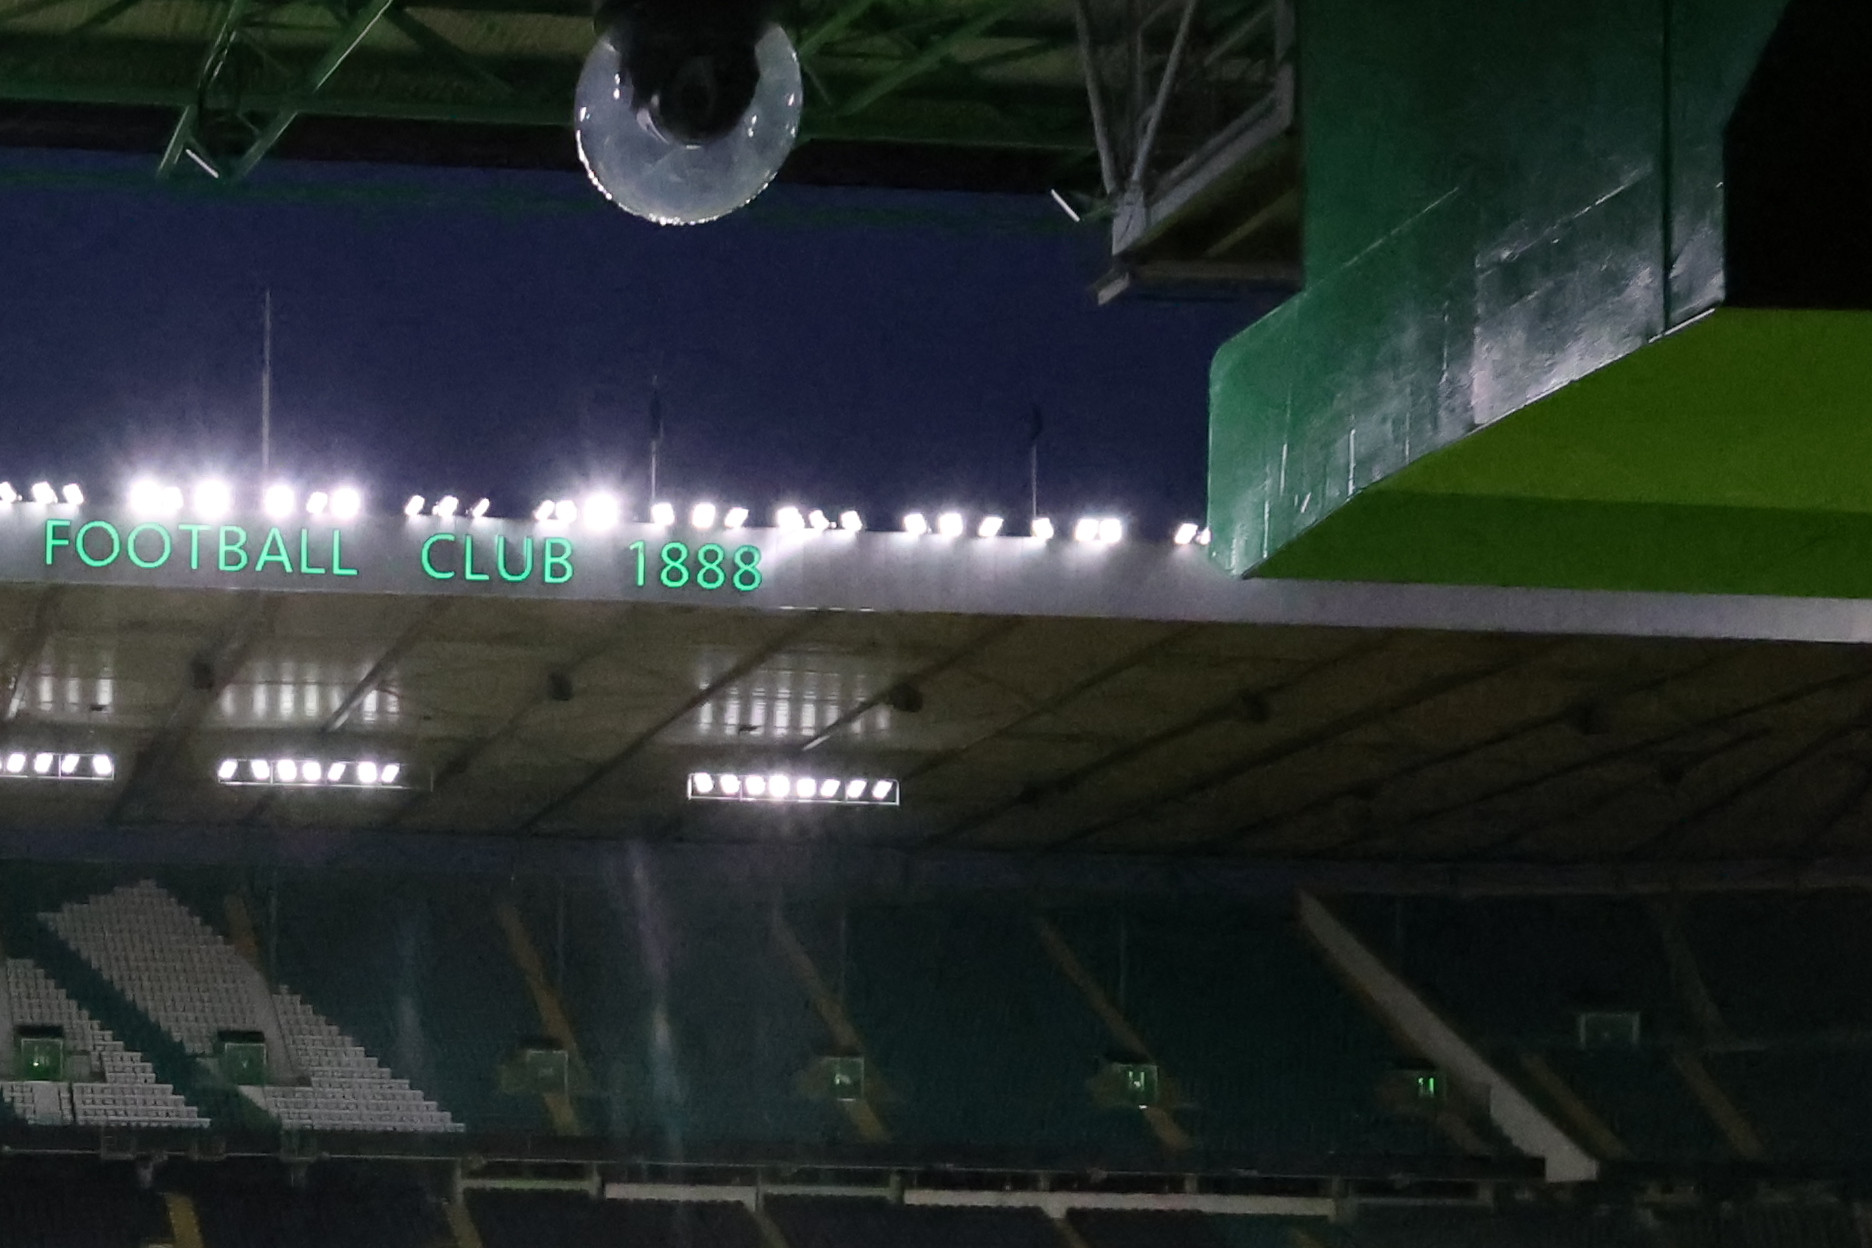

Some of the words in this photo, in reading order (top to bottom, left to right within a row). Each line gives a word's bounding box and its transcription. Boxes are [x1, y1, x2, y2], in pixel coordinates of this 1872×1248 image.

[45, 518, 359, 576] FOOTBALL
[421, 533, 574, 584] CLUB
[629, 541, 763, 592] 1888
